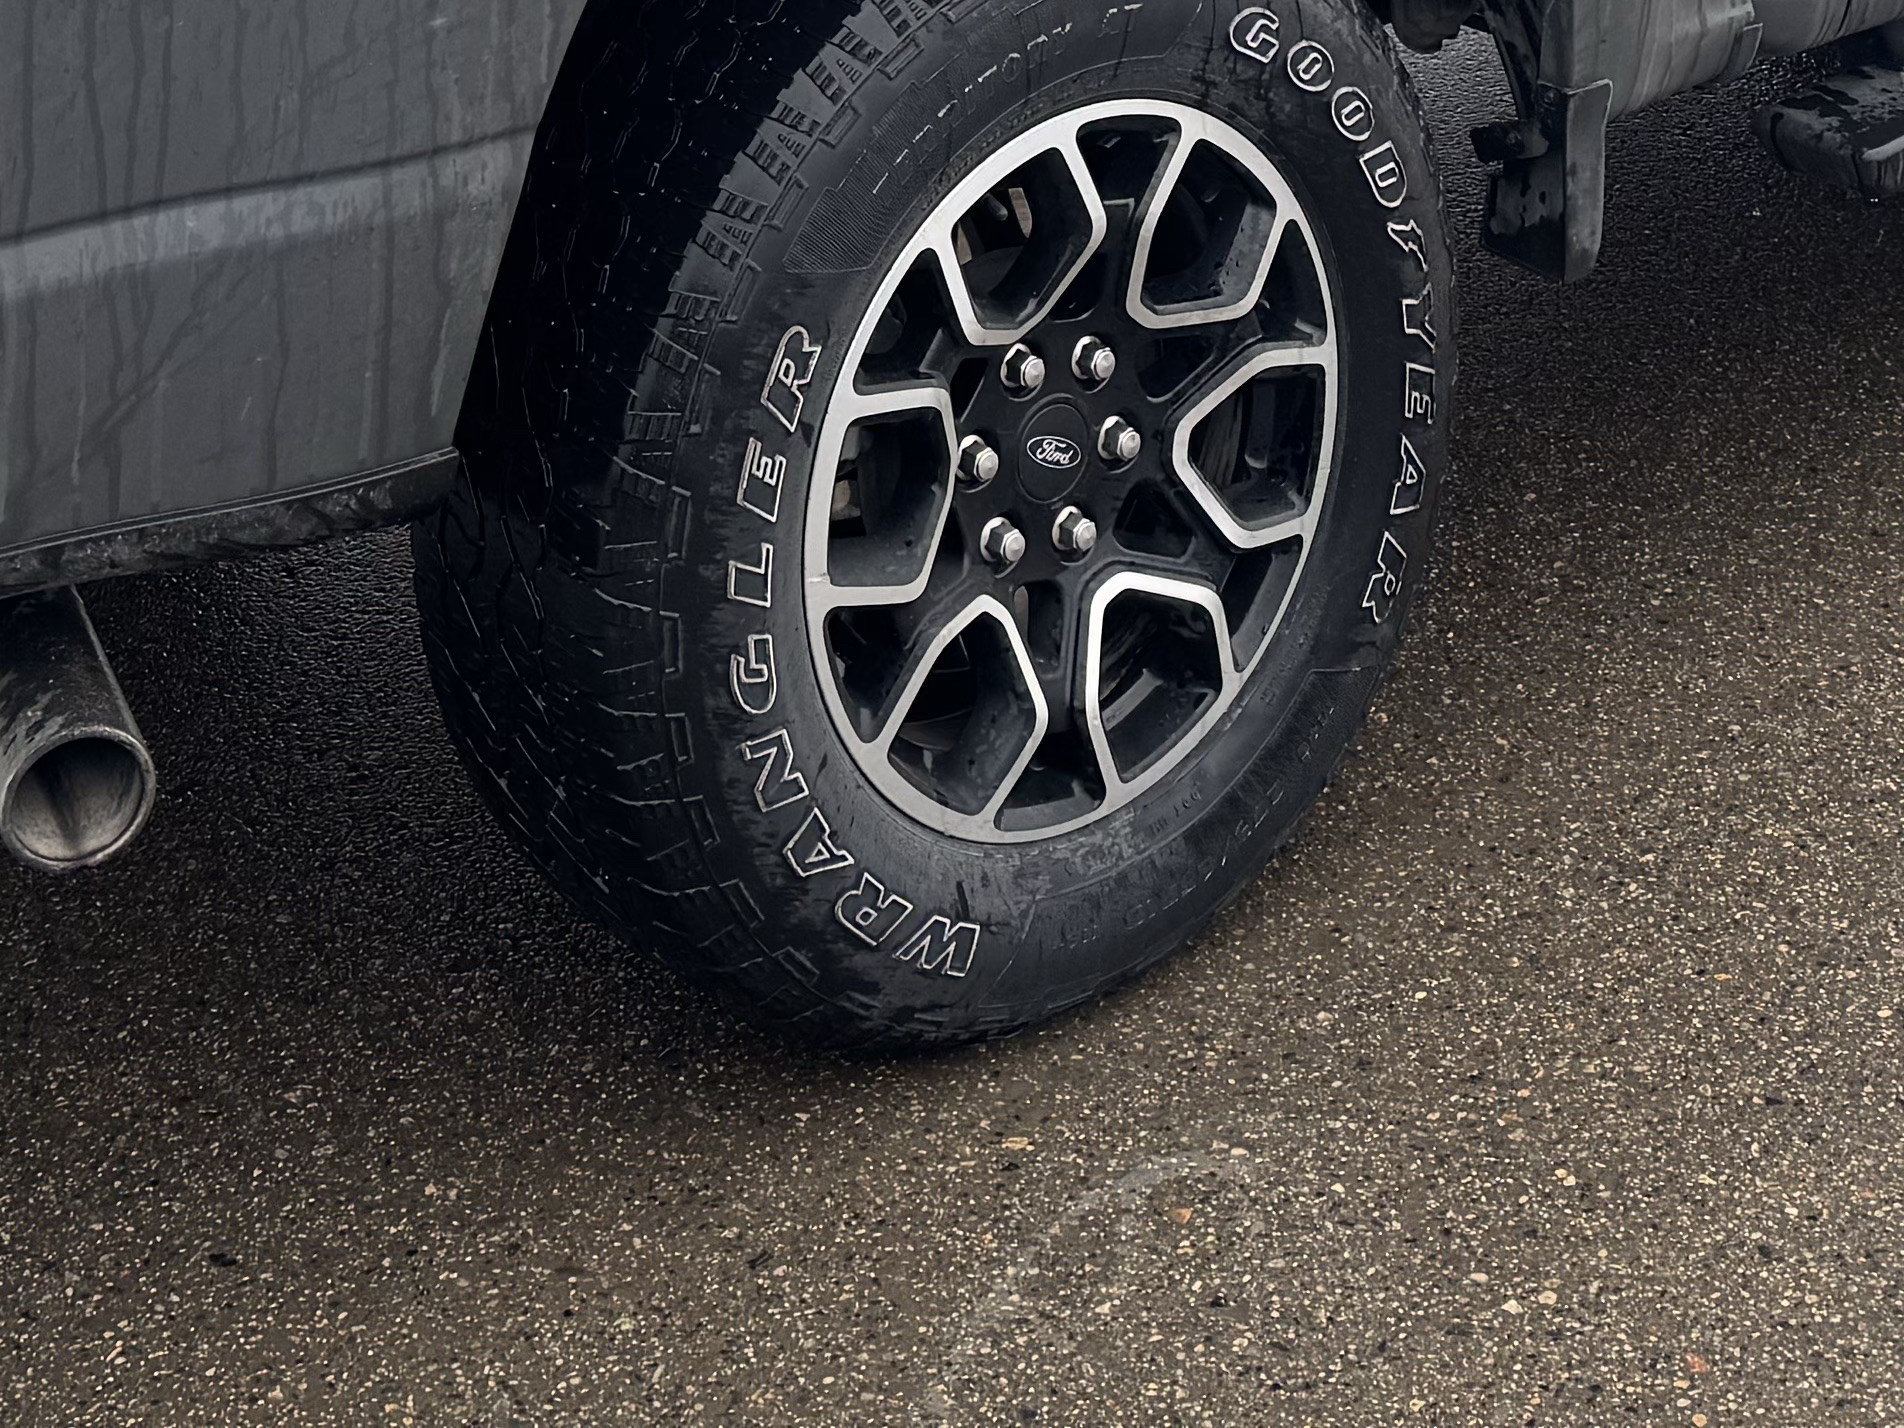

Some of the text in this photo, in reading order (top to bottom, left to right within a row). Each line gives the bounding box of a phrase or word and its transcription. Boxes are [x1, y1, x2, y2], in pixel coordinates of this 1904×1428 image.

[1035, 438, 1074, 466] Ford
[1228, 5, 1437, 625] GOODYEAR
[727, 324, 981, 978] WRANGLER
